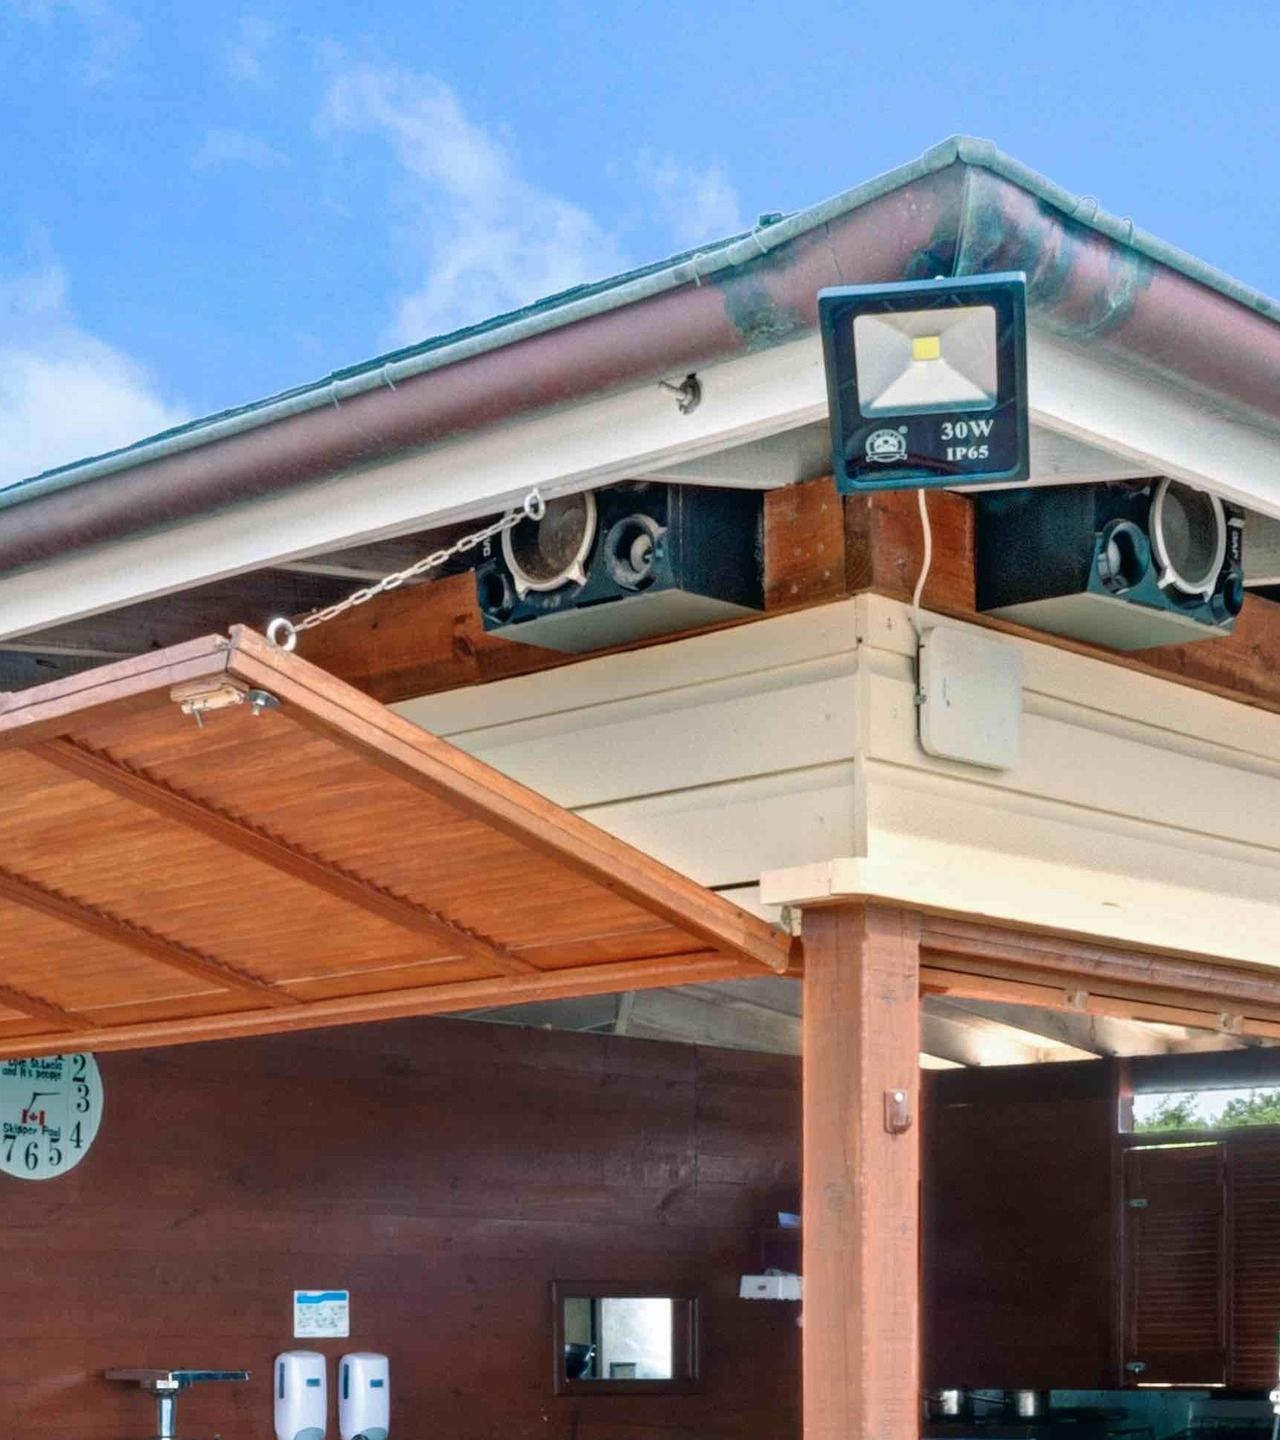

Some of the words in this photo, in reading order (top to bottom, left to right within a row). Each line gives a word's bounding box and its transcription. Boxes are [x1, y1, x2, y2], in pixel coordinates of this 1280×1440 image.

[940, 419, 994, 441] 30W
[946, 445, 989, 461] IP65
[72, 1054, 86, 1083] 2
[76, 1083, 90, 1113] 3
[2, 1122, 38, 1136] Skipper
[69, 1121, 83, 1149] 4
[3, 1134, 17, 1162] 7
[24, 1141, 39, 1171] 6
[48, 1137, 62, 1167] 5
